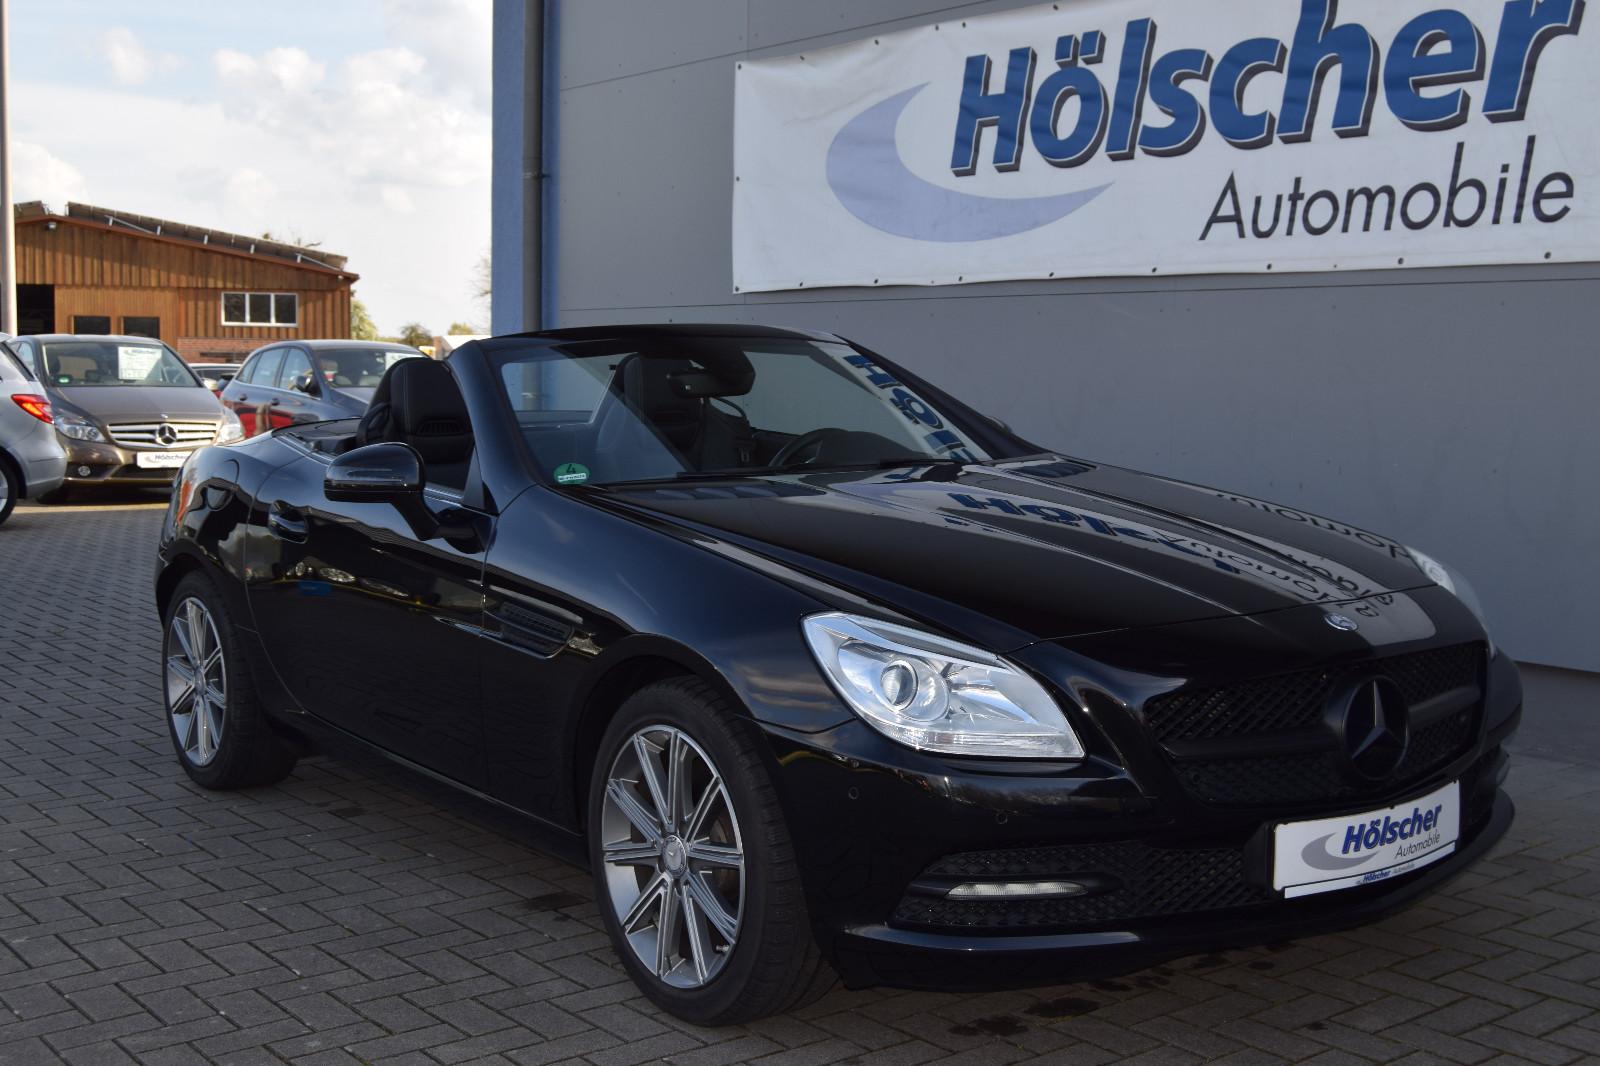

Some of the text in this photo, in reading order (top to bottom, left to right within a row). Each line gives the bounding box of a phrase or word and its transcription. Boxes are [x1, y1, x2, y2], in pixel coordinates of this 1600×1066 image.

[950, 0, 1586, 177] Hölscher
[1199, 134, 1574, 241] Automobile
[566, 464, 576, 474] 4
[1342, 804, 1442, 855] Hölscher
[1395, 829, 1440, 860] Automobile
